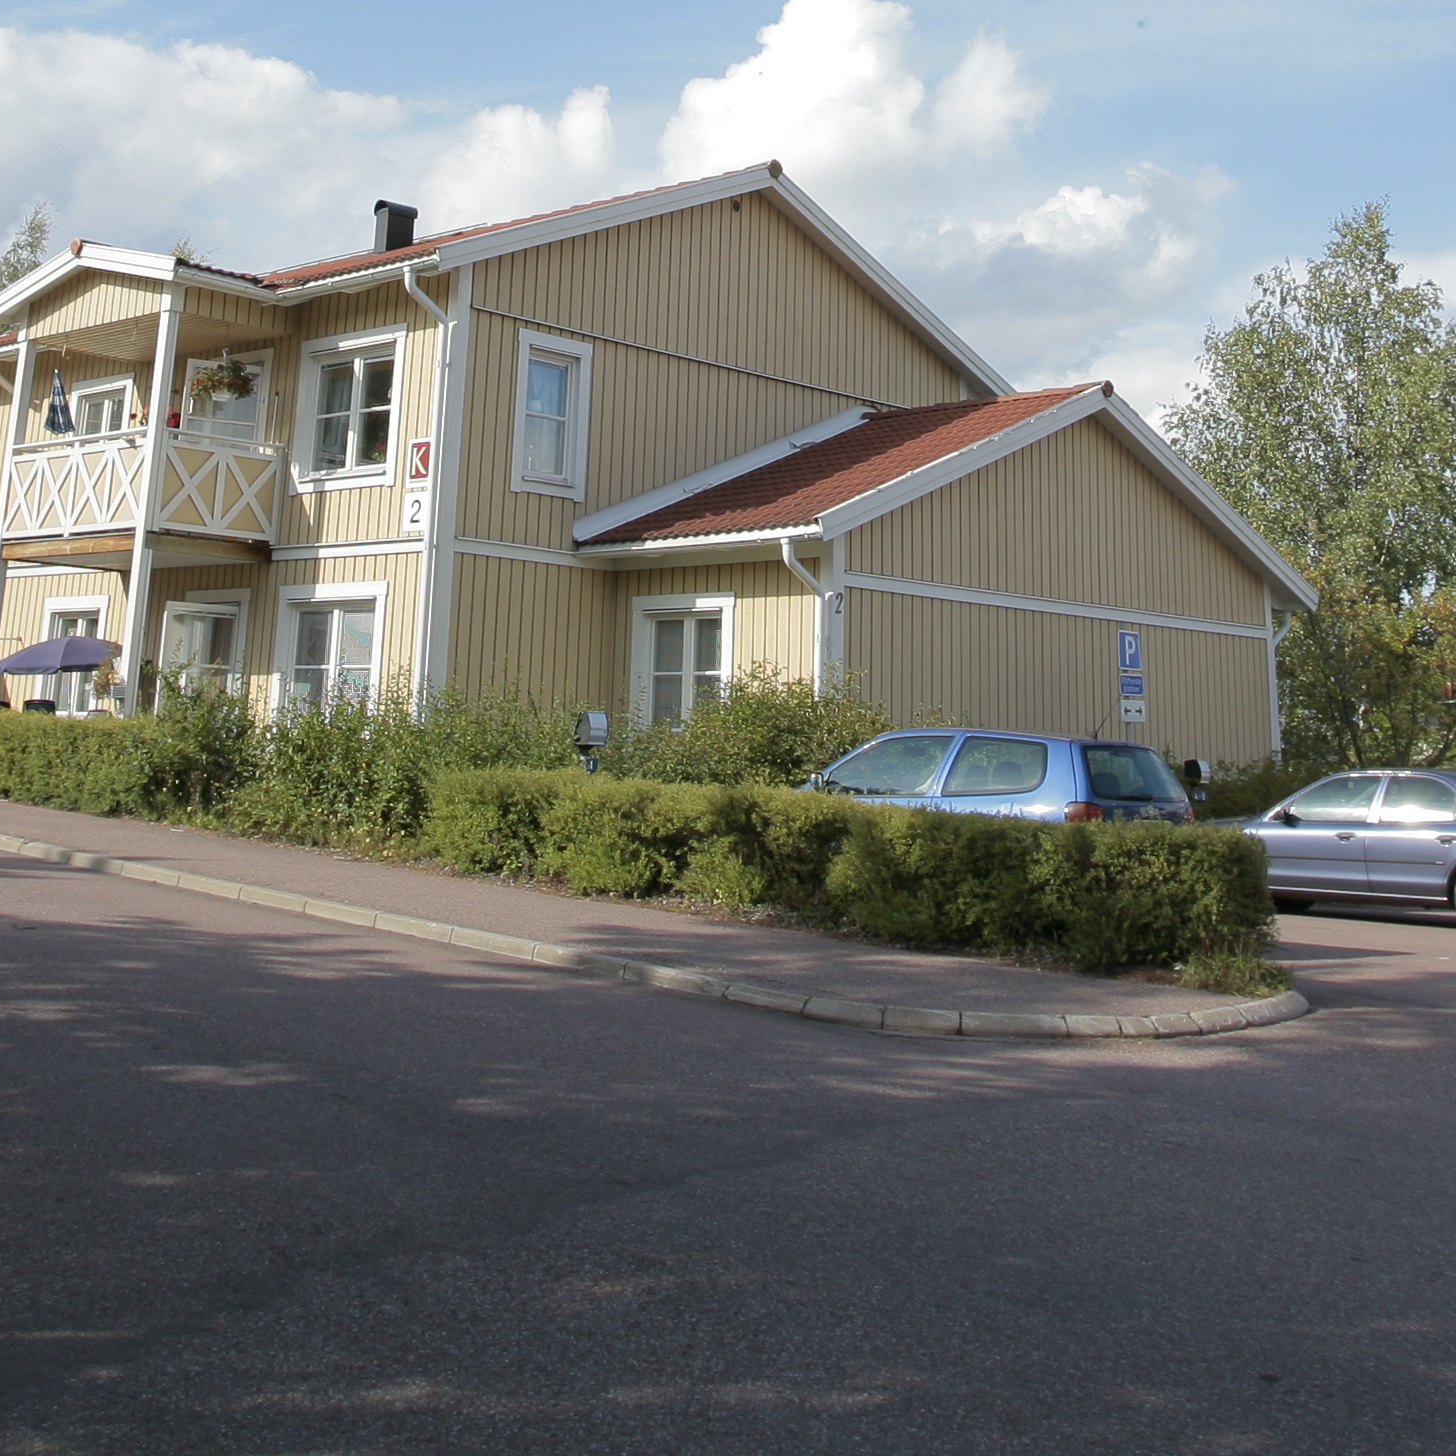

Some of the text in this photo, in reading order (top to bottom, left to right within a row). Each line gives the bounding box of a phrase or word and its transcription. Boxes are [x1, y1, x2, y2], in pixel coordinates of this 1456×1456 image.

[411, 446, 427, 476] K
[410, 499, 422, 523] 2
[834, 591, 844, 614] 2
[1125, 635, 1136, 666] P
